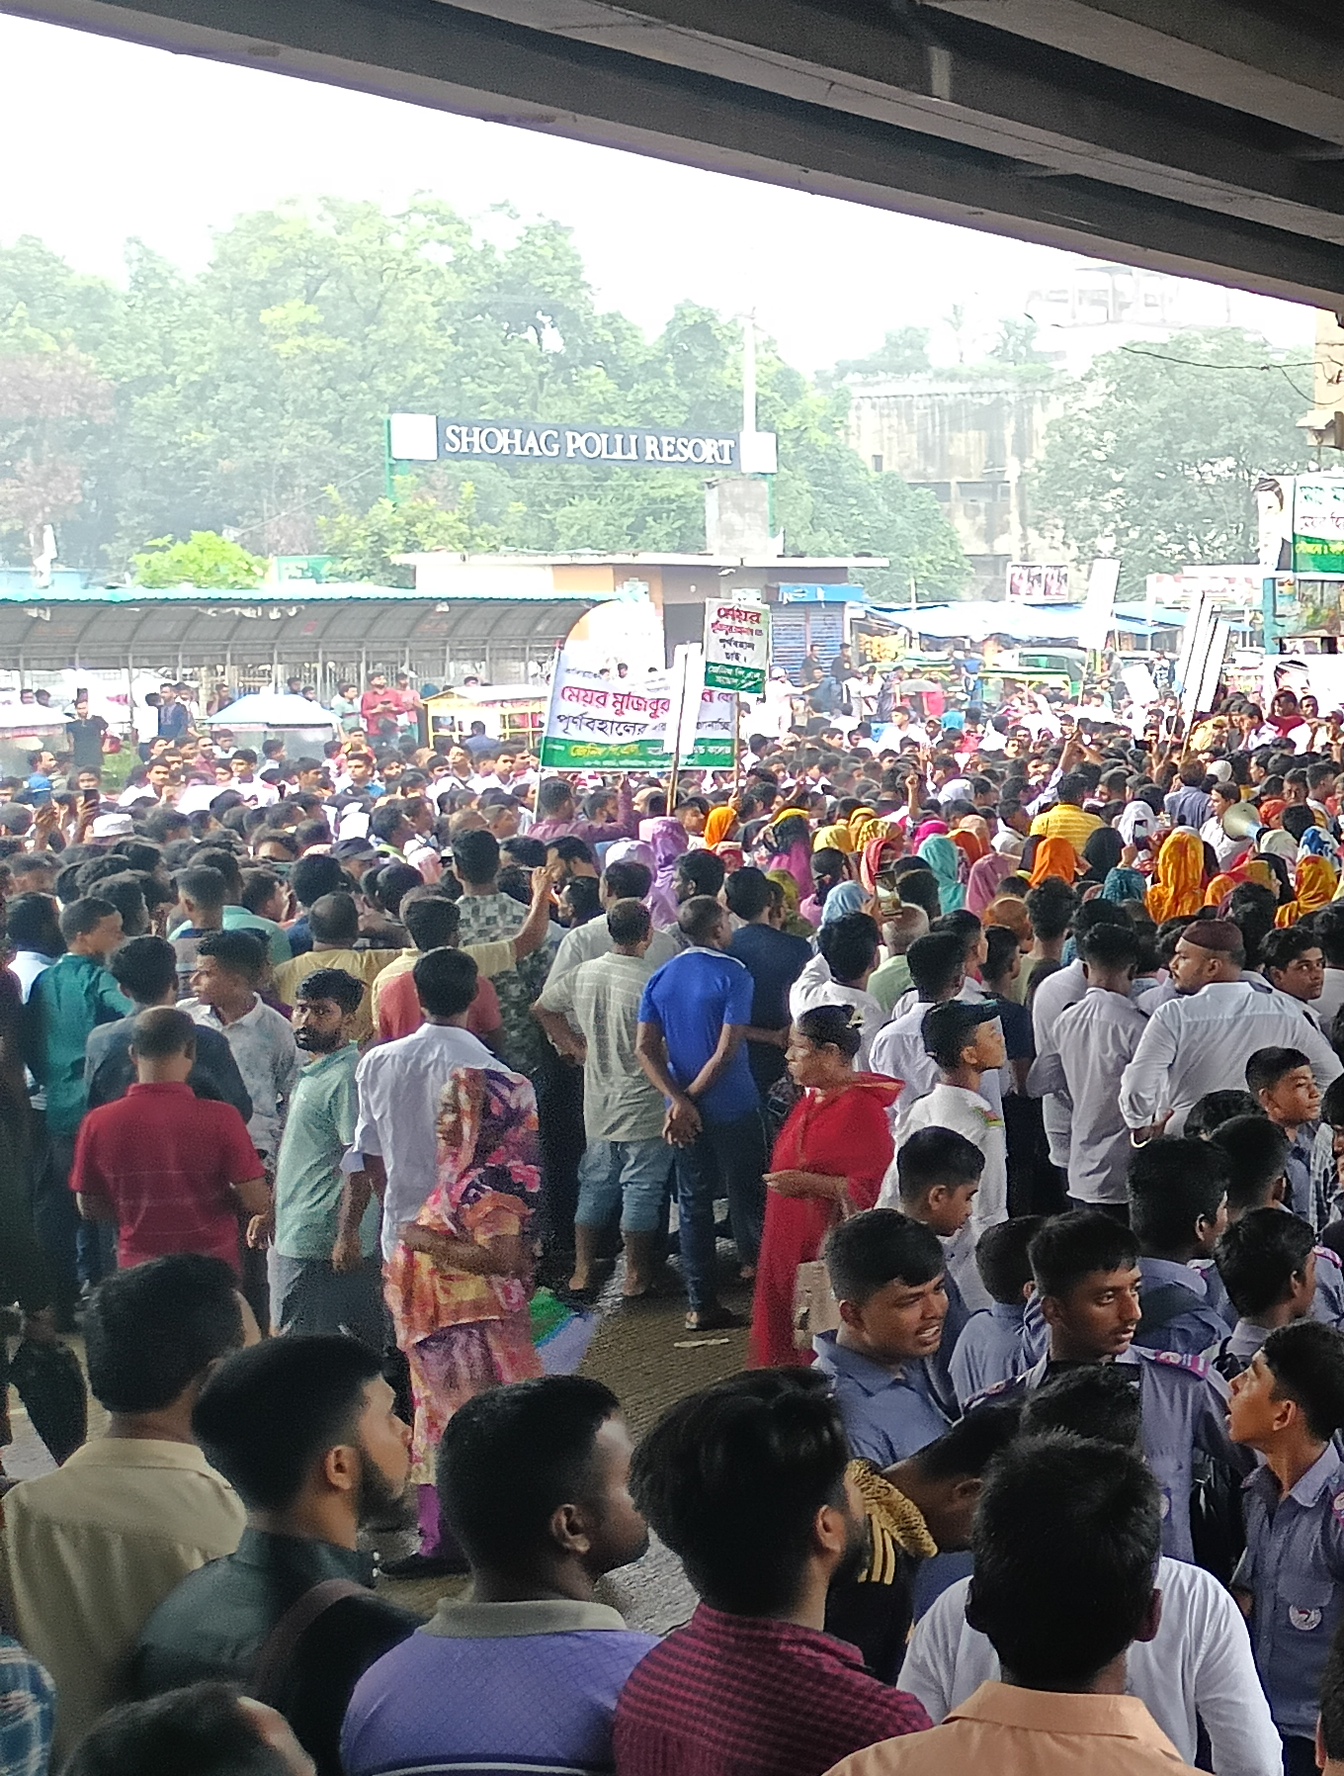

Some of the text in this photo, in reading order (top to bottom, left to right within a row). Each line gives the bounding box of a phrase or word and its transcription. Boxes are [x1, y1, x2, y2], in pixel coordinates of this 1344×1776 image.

[444, 424, 736, 465] SHOHAG POLLI RESORT
[561, 685, 609, 710] মেয়র
[612, 691, 671, 719] মুজিবুর
[556, 711, 650, 736] পূর্ণবহালের
